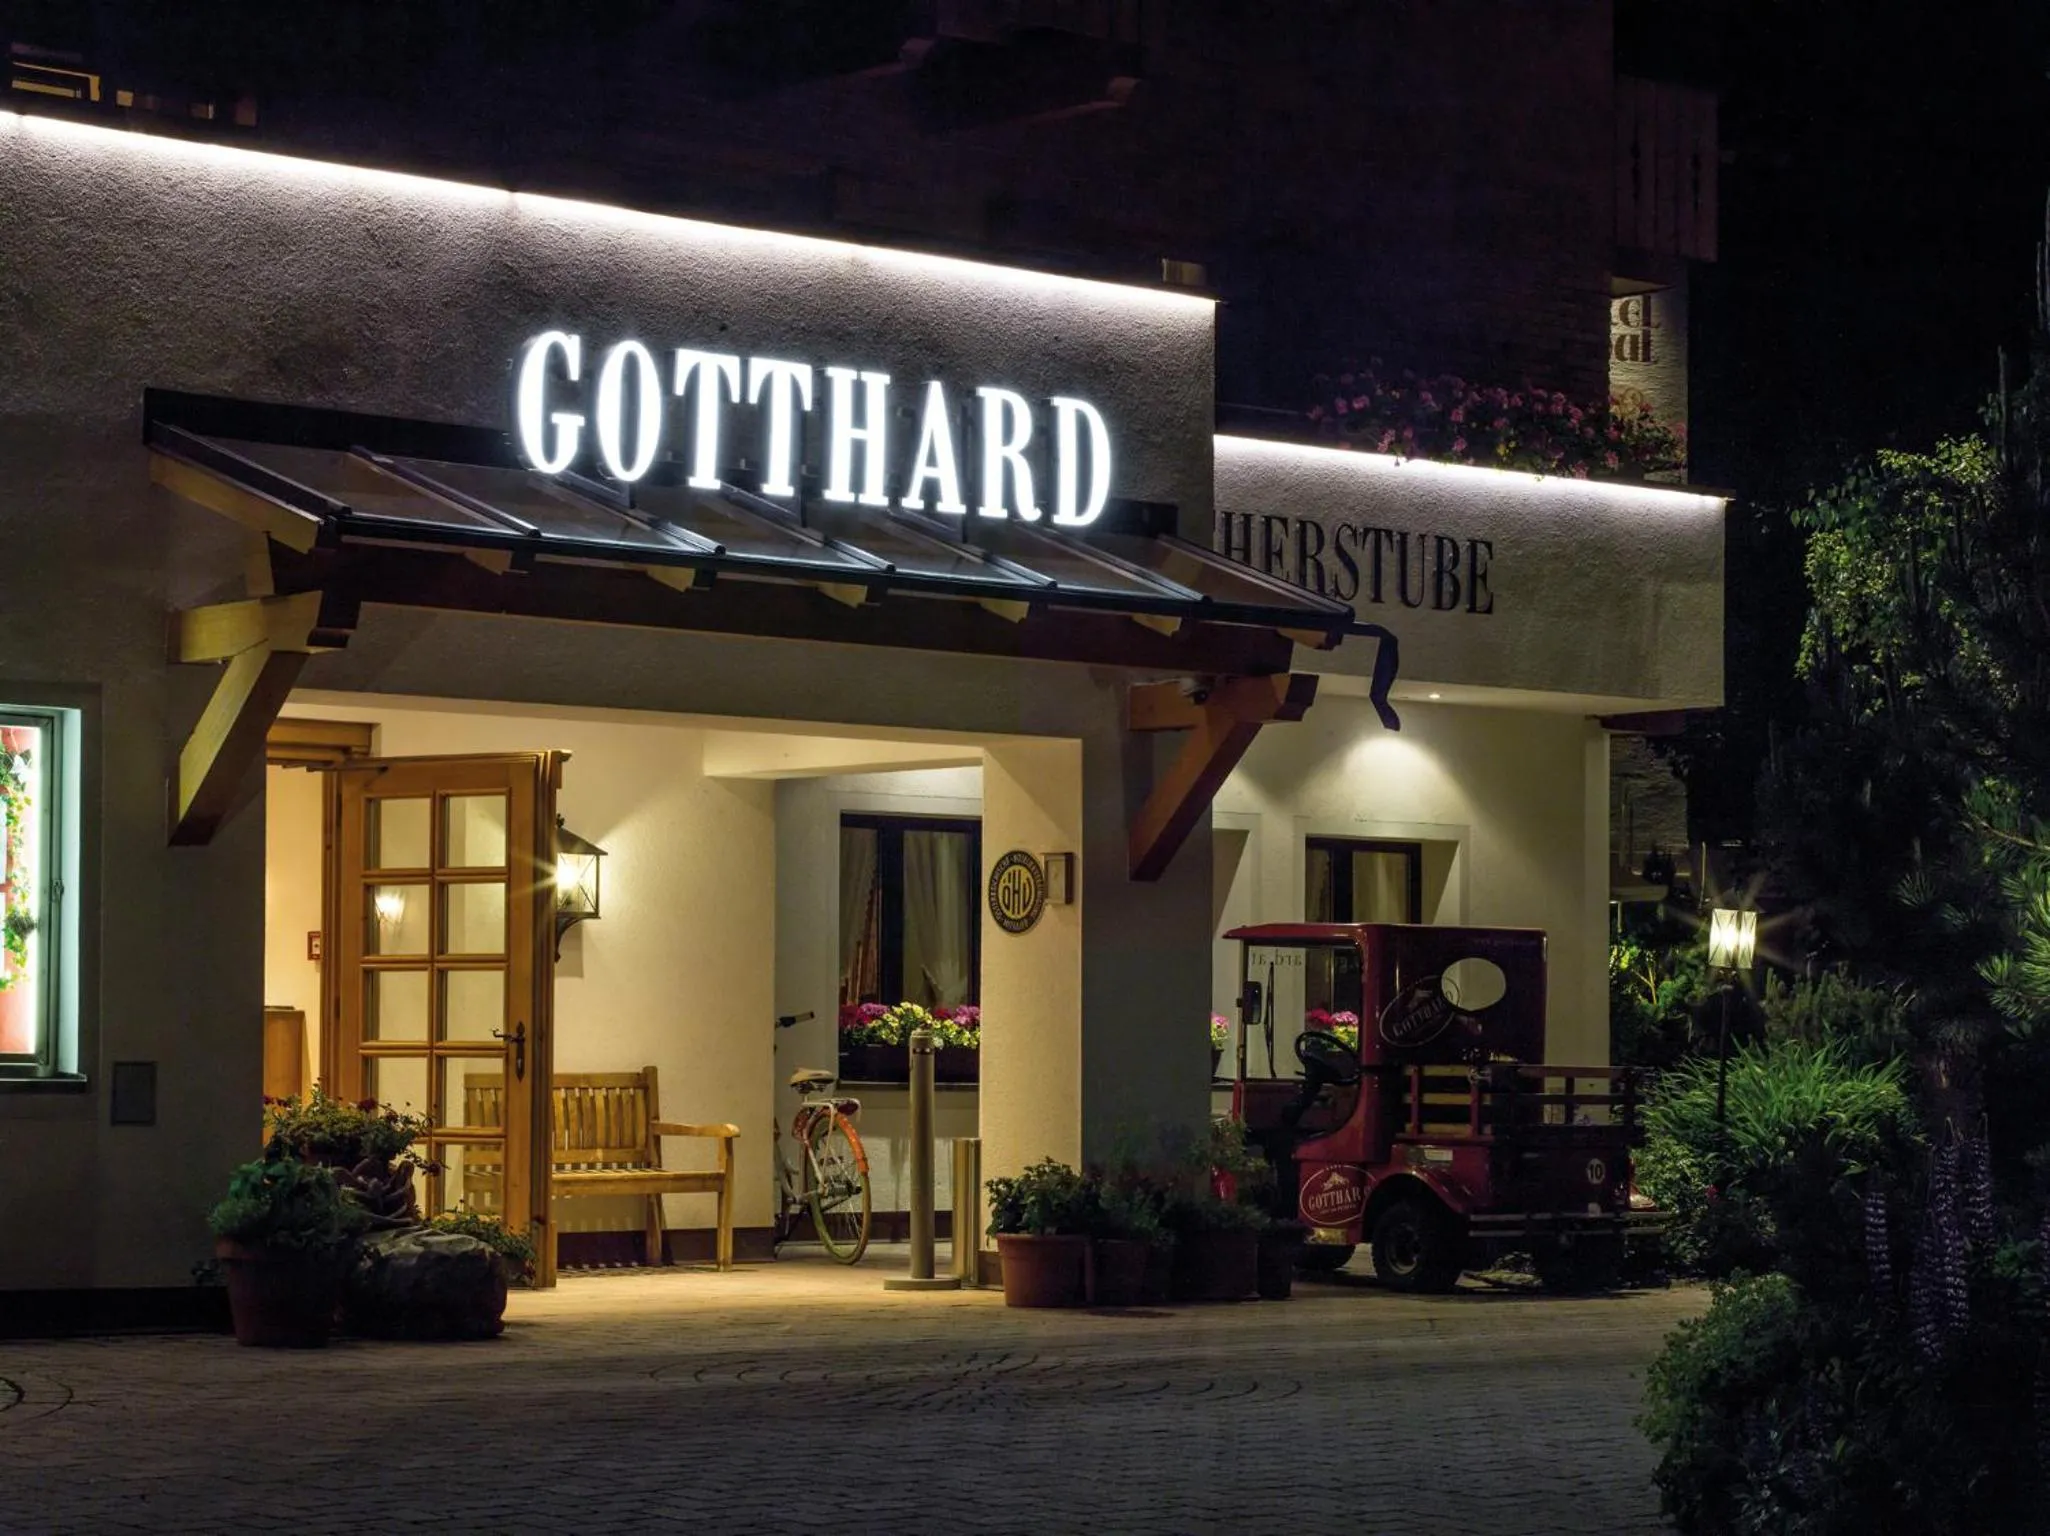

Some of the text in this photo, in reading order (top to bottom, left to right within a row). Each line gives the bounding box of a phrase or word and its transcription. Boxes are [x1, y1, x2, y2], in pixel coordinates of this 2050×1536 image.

[518, 330, 1112, 526] GOTTHARD
[1213, 510, 1493, 614] HERSTUBE
[1590, 1164, 1603, 1179] 10
